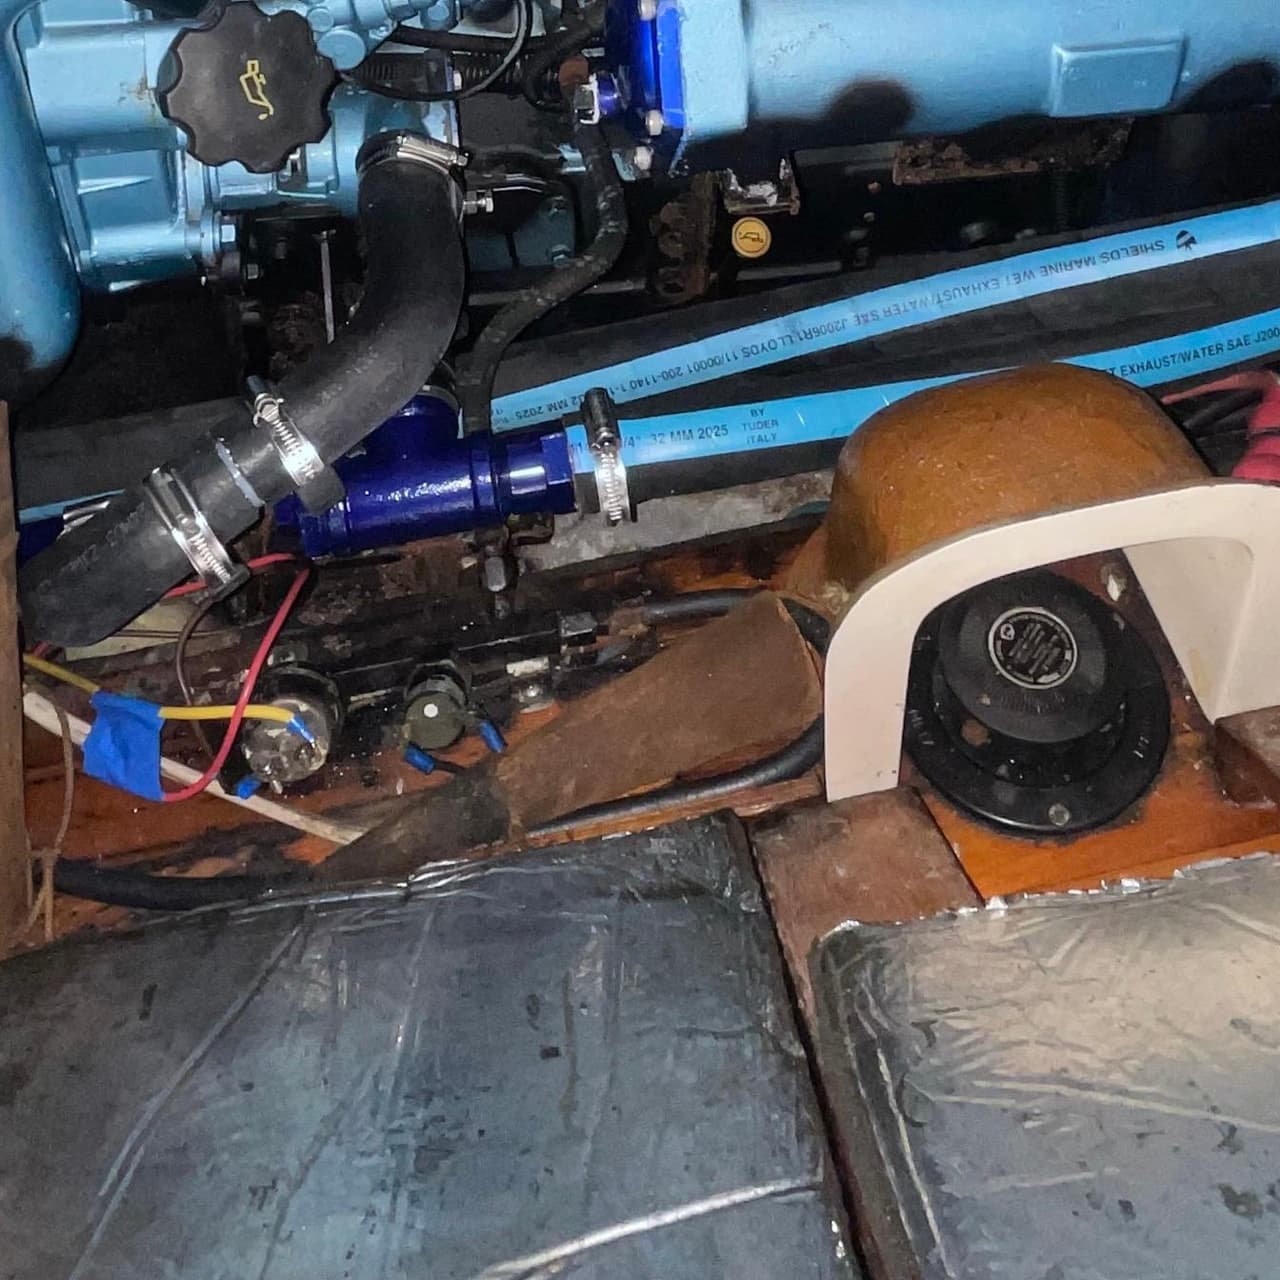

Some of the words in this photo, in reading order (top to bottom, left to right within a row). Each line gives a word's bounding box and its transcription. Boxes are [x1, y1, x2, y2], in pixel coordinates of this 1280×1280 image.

[1101, 239, 1166, 265] SHIELDS
[1039, 255, 1096, 278] MARINE
[884, 280, 1001, 319] EXHAUST/WATER
[797, 319, 847, 341] J2006R1
[853, 310, 881, 328] SAE
[741, 334, 794, 358] LLOYDS
[1120, 343, 1225, 377] EXHAUST/WATER
[1227, 334, 1252, 351] SAE
[687, 347, 739, 376] 11/00001
[629, 366, 684, 391] 200-1140
[514, 405, 545, 420] 2025
[545, 400, 569, 414] MM
[749, 407, 765, 418] BY
[650, 433, 666, 445] 32
[669, 429, 694, 442] MM
[697, 424, 729, 440] 2025
[741, 419, 780, 432] TUDER
[746, 432, 778, 445] ITALY
